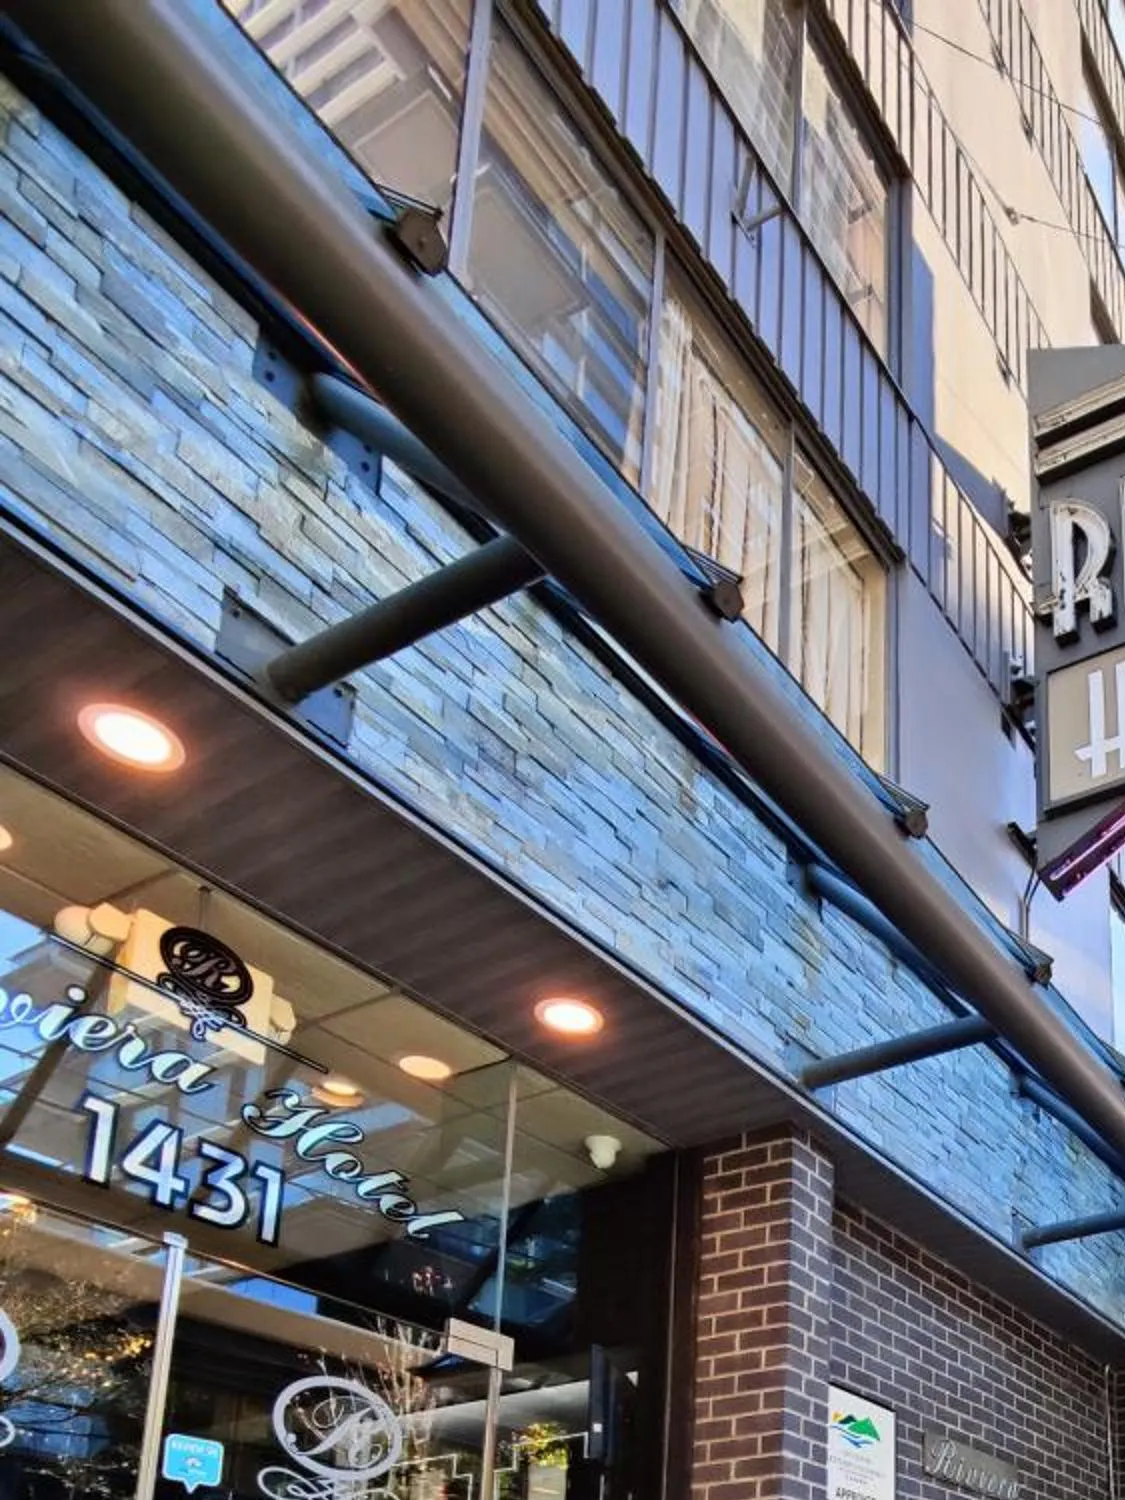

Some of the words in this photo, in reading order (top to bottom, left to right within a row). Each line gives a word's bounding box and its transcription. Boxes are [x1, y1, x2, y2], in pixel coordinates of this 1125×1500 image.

[81, 1093, 286, 1247] 1431
[241, 1087, 464, 1241] Hotel
[925, 1439, 1021, 1500] Riviera
